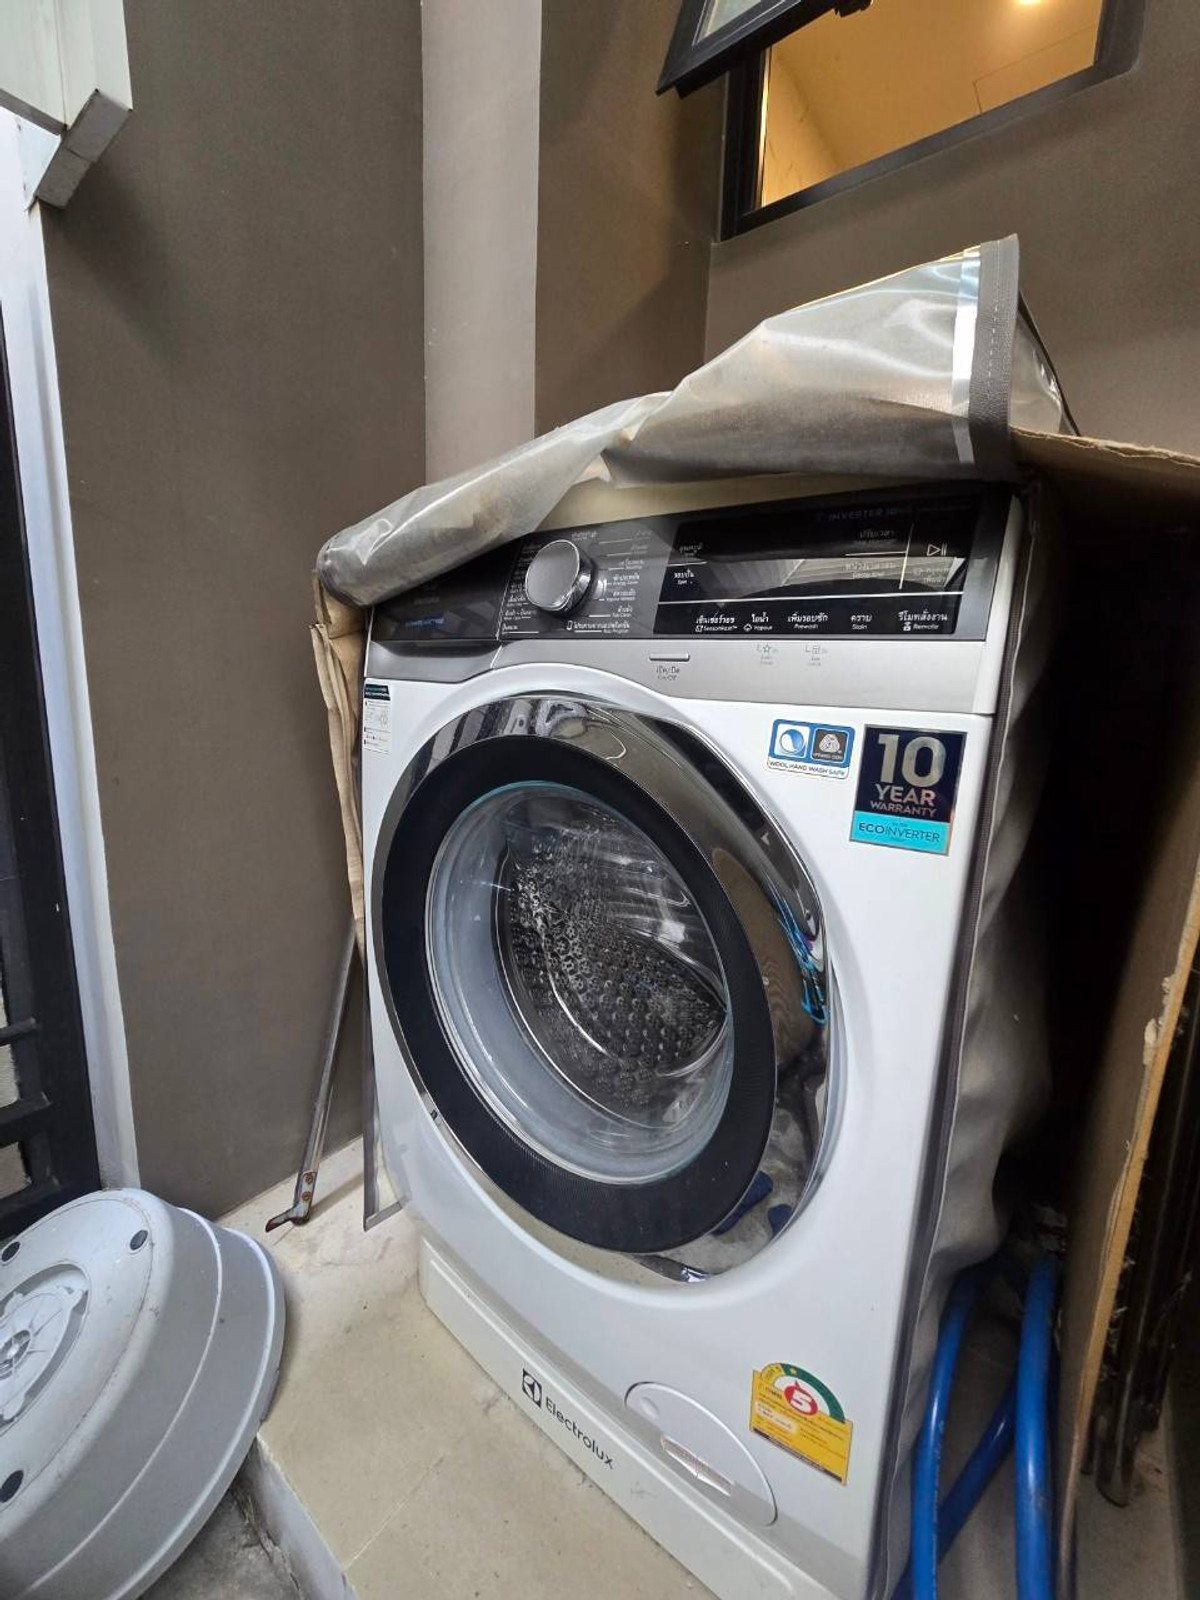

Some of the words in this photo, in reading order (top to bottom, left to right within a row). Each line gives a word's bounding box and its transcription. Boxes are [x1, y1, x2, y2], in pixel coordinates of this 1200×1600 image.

[769, 760, 788, 769] WOOL
[789, 762, 807, 771] HAND
[808, 765, 828, 774] WASH
[878, 733, 947, 788] 10
[875, 783, 936, 807] YEAR
[870, 799, 937, 818] WARRANTY
[858, 821, 940, 843] ECOINVERTER
[789, 1388, 813, 1415] 5
[545, 1394, 614, 1470] Electrolux
